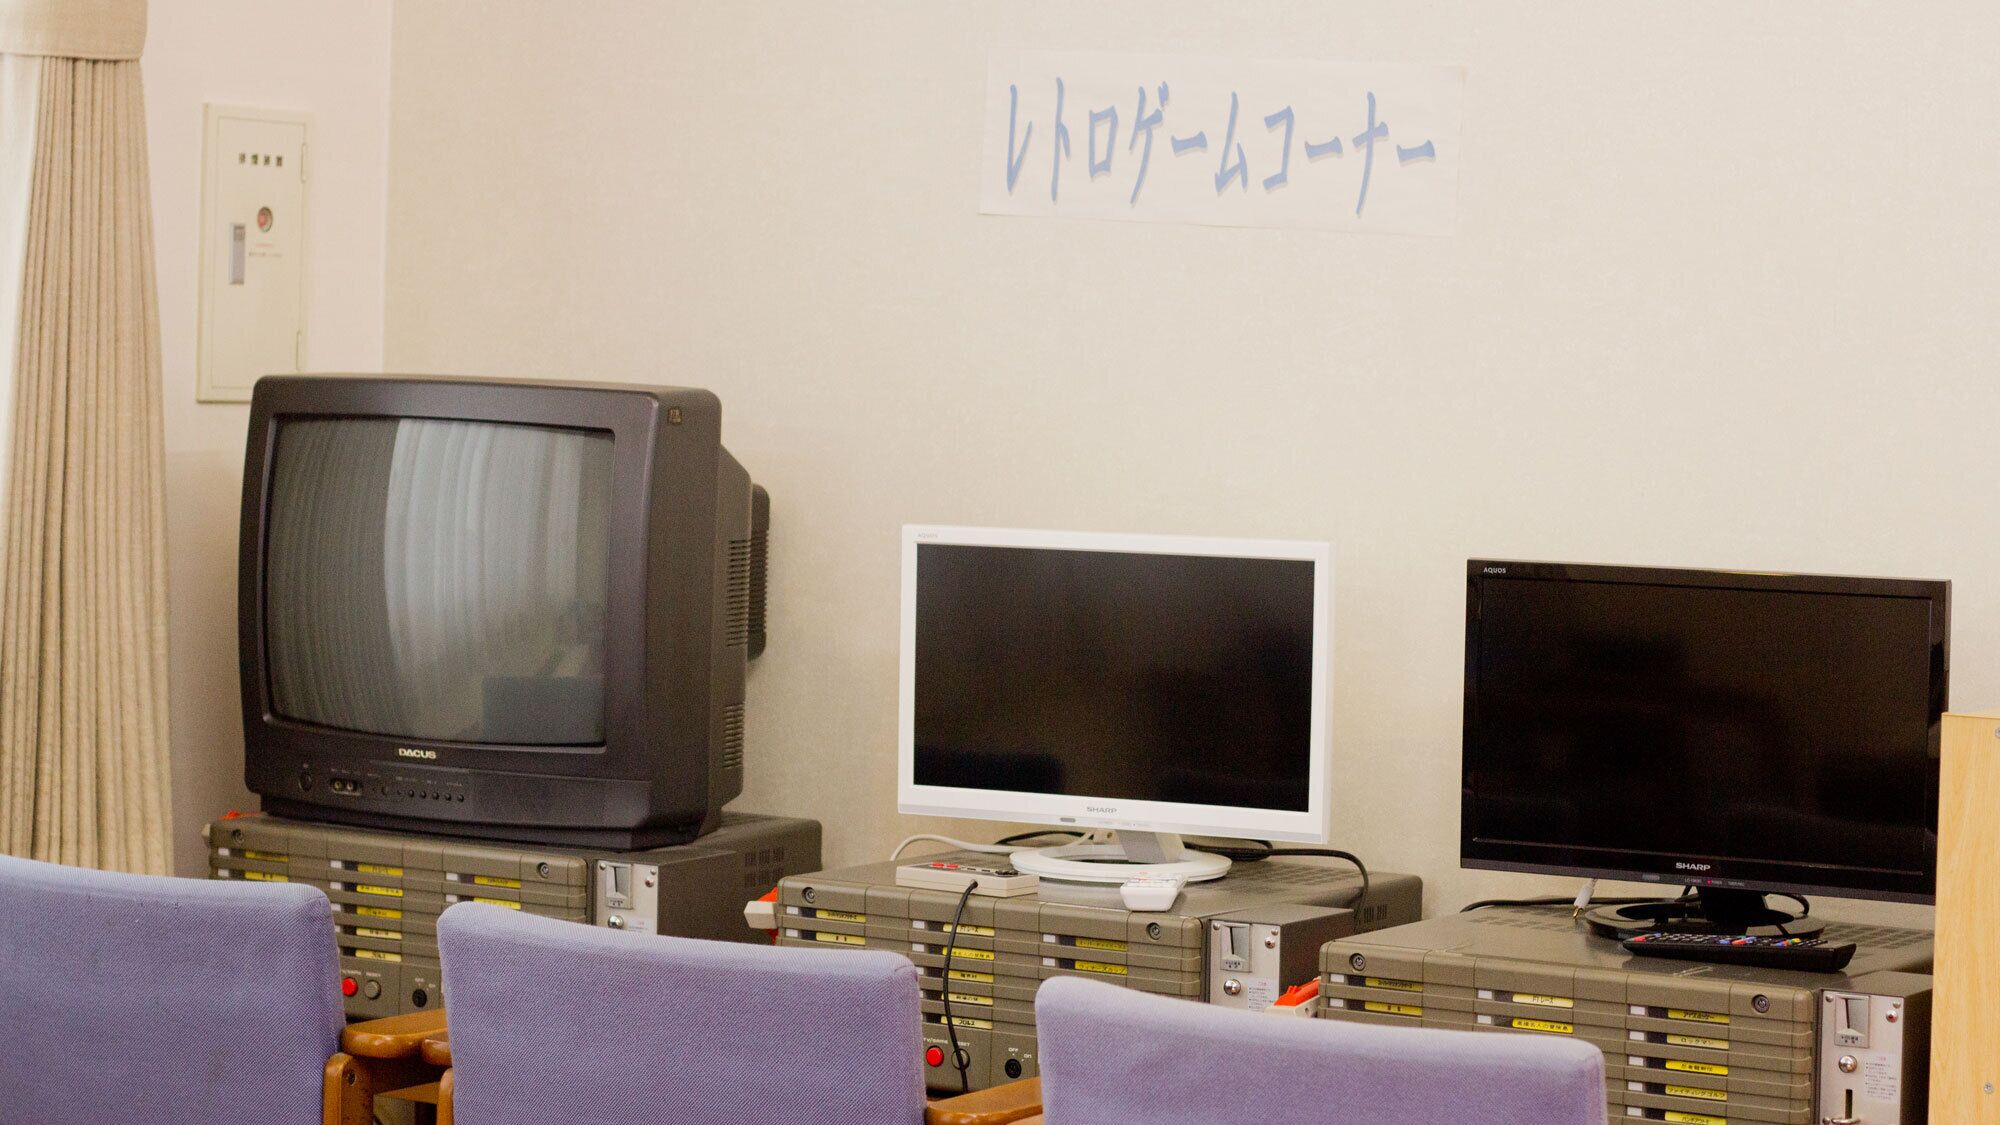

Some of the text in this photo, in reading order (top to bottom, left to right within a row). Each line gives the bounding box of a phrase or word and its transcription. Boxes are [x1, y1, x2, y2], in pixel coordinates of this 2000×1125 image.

[1007, 77, 1435, 217] レトロゲームコーナー
[398, 748, 437, 759] DACUS
[1675, 862, 1711, 871] SHARP
